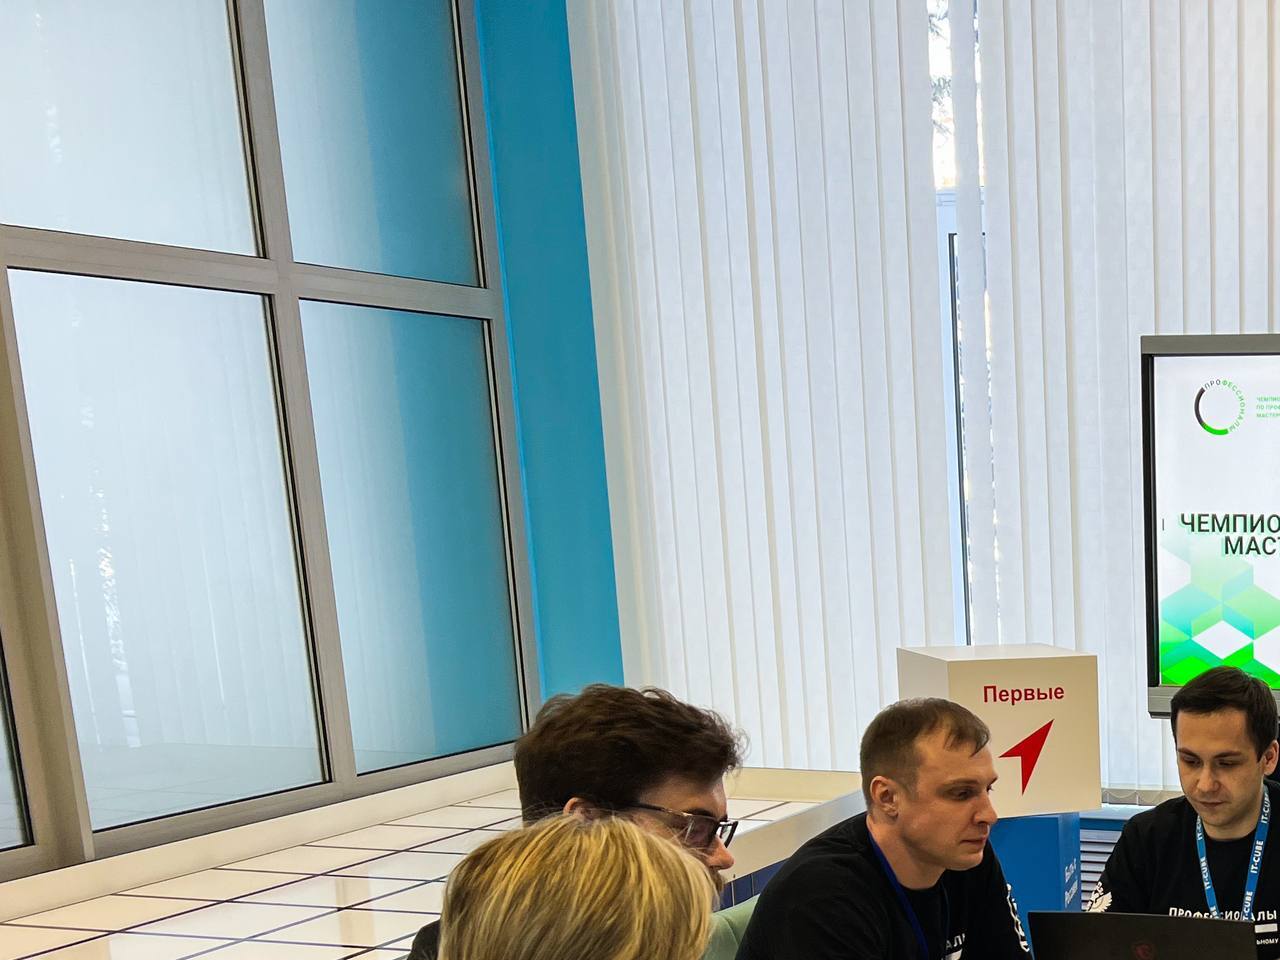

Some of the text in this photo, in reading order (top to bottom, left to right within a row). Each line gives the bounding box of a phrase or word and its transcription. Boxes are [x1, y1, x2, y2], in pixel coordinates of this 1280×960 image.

[1204, 378, 1246, 432] ПРОФЕССИОНАЛЫ
[983, 685, 1065, 706] Первые
[1250, 840, 1265, 874] IT-CUBE
[1242, 891, 1254, 921] T-CUBE
